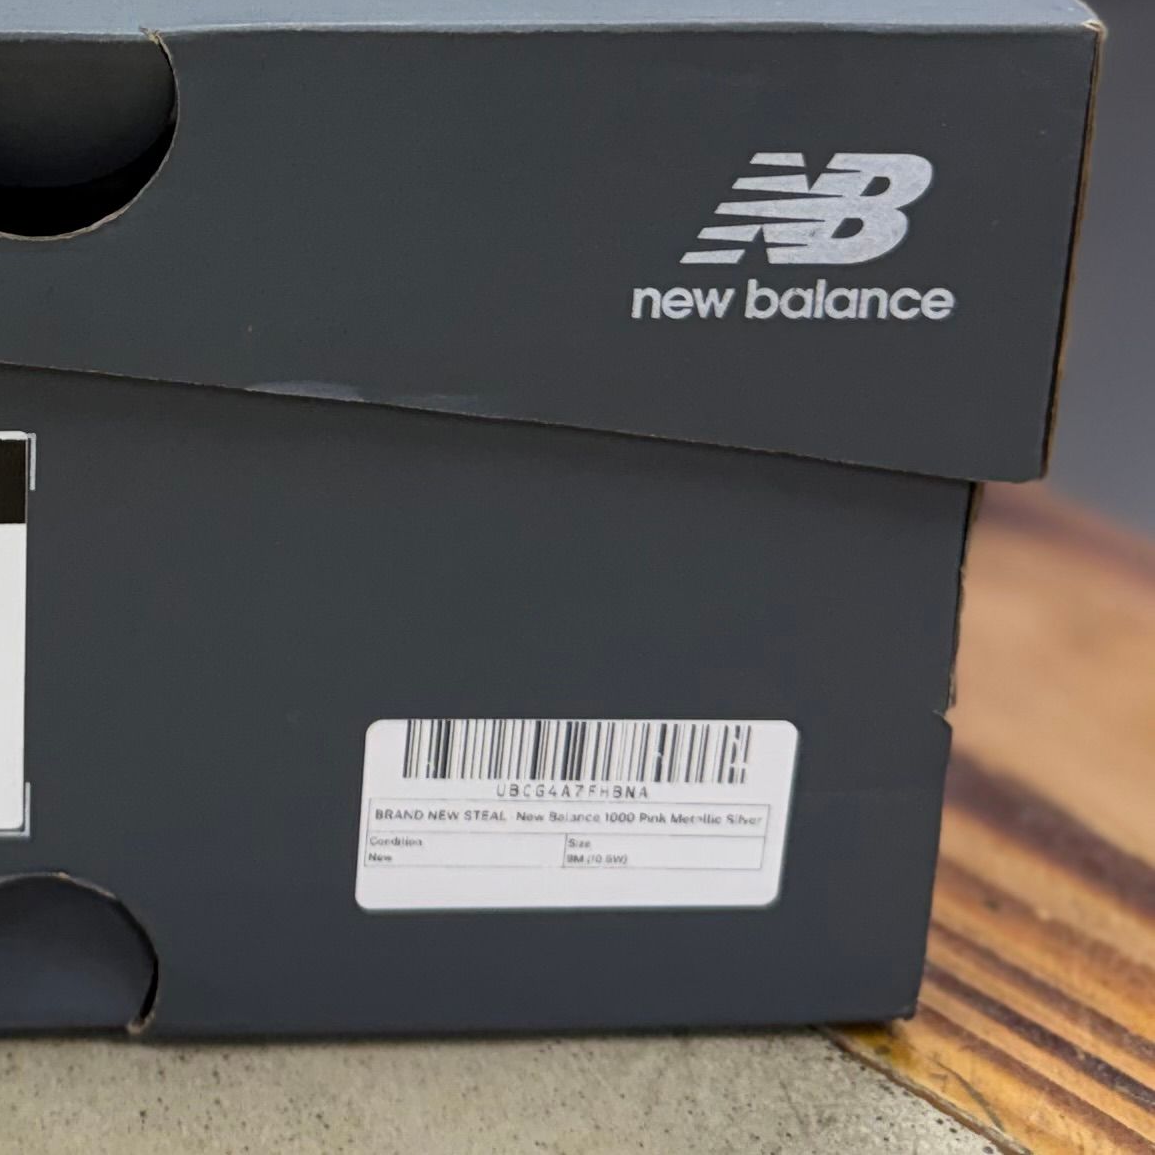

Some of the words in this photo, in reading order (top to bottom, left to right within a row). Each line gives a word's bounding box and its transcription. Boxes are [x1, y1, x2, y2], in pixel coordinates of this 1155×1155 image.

[679, 152, 933, 264] NB
[631, 286, 736, 319] new
[744, 278, 955, 320] balance
[375, 809, 424, 821] BRAND
[428, 810, 459, 821] NEW
[516, 811, 544, 822] New
[549, 811, 600, 823] Balance
[605, 812, 635, 824] 1000
[640, 812, 667, 824] Pink
[369, 836, 423, 847] Condition
[368, 853, 393, 863] New
